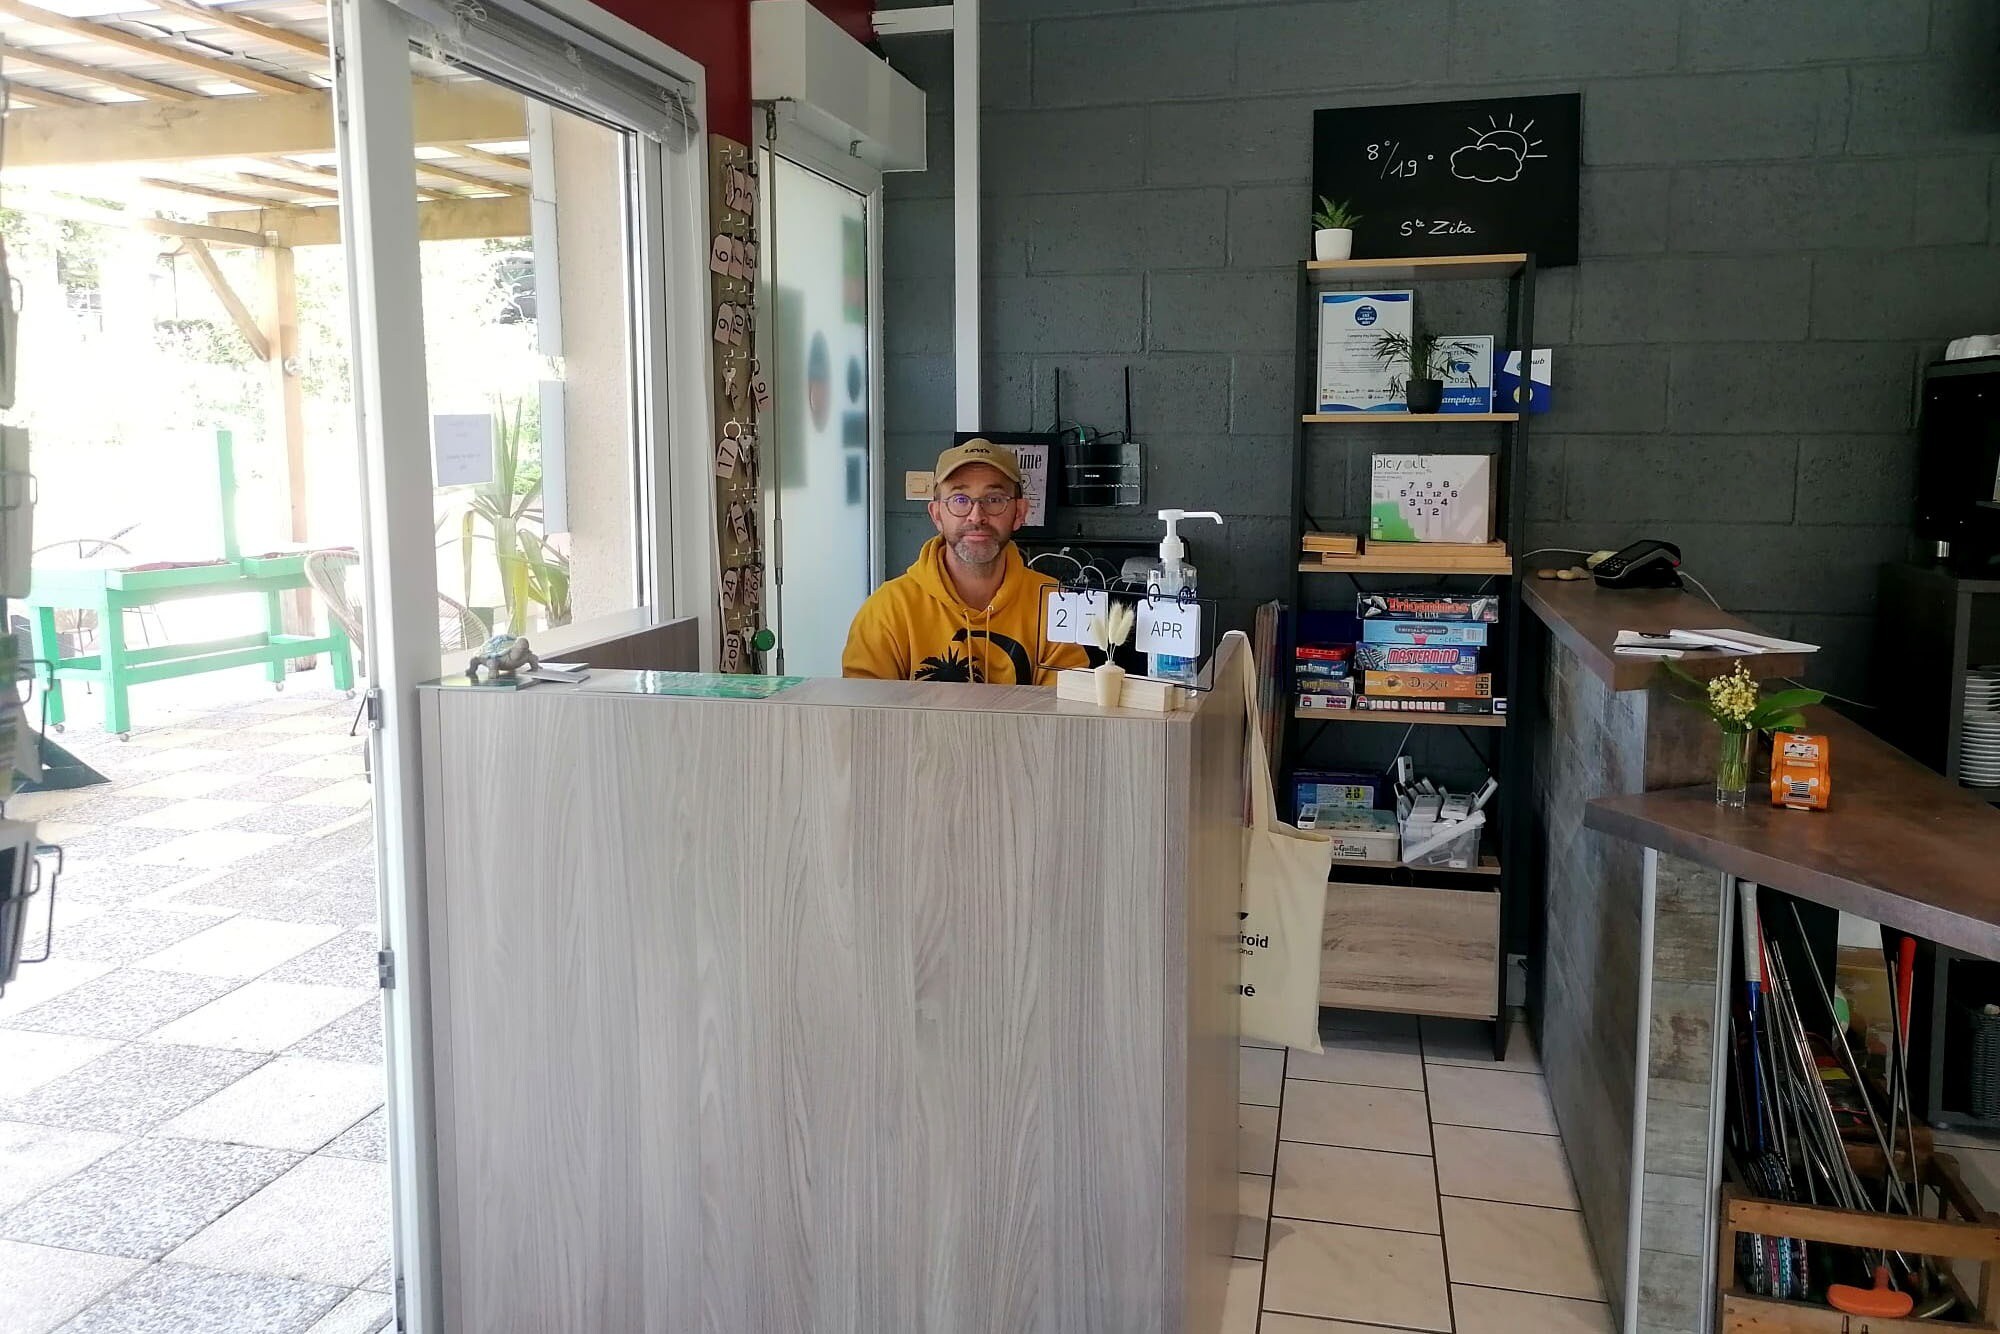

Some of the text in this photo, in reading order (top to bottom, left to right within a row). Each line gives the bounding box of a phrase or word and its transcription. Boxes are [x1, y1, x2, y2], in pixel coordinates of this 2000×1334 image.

[1428, 221, 1476, 234] Zita
[715, 249, 729, 262] 6
[718, 318, 730, 331] 9
[732, 314, 744, 336] 10
[754, 382, 769, 404] 16
[1442, 395, 1478, 407] amping
[718, 447, 735, 468] 17
[1451, 490, 1458, 498] 6
[1441, 498, 1448, 506] 4
[1416, 508, 1440, 516] 1 2
[734, 515, 746, 537] 21
[723, 579, 736, 603] 24
[1151, 620, 1182, 640] APR
